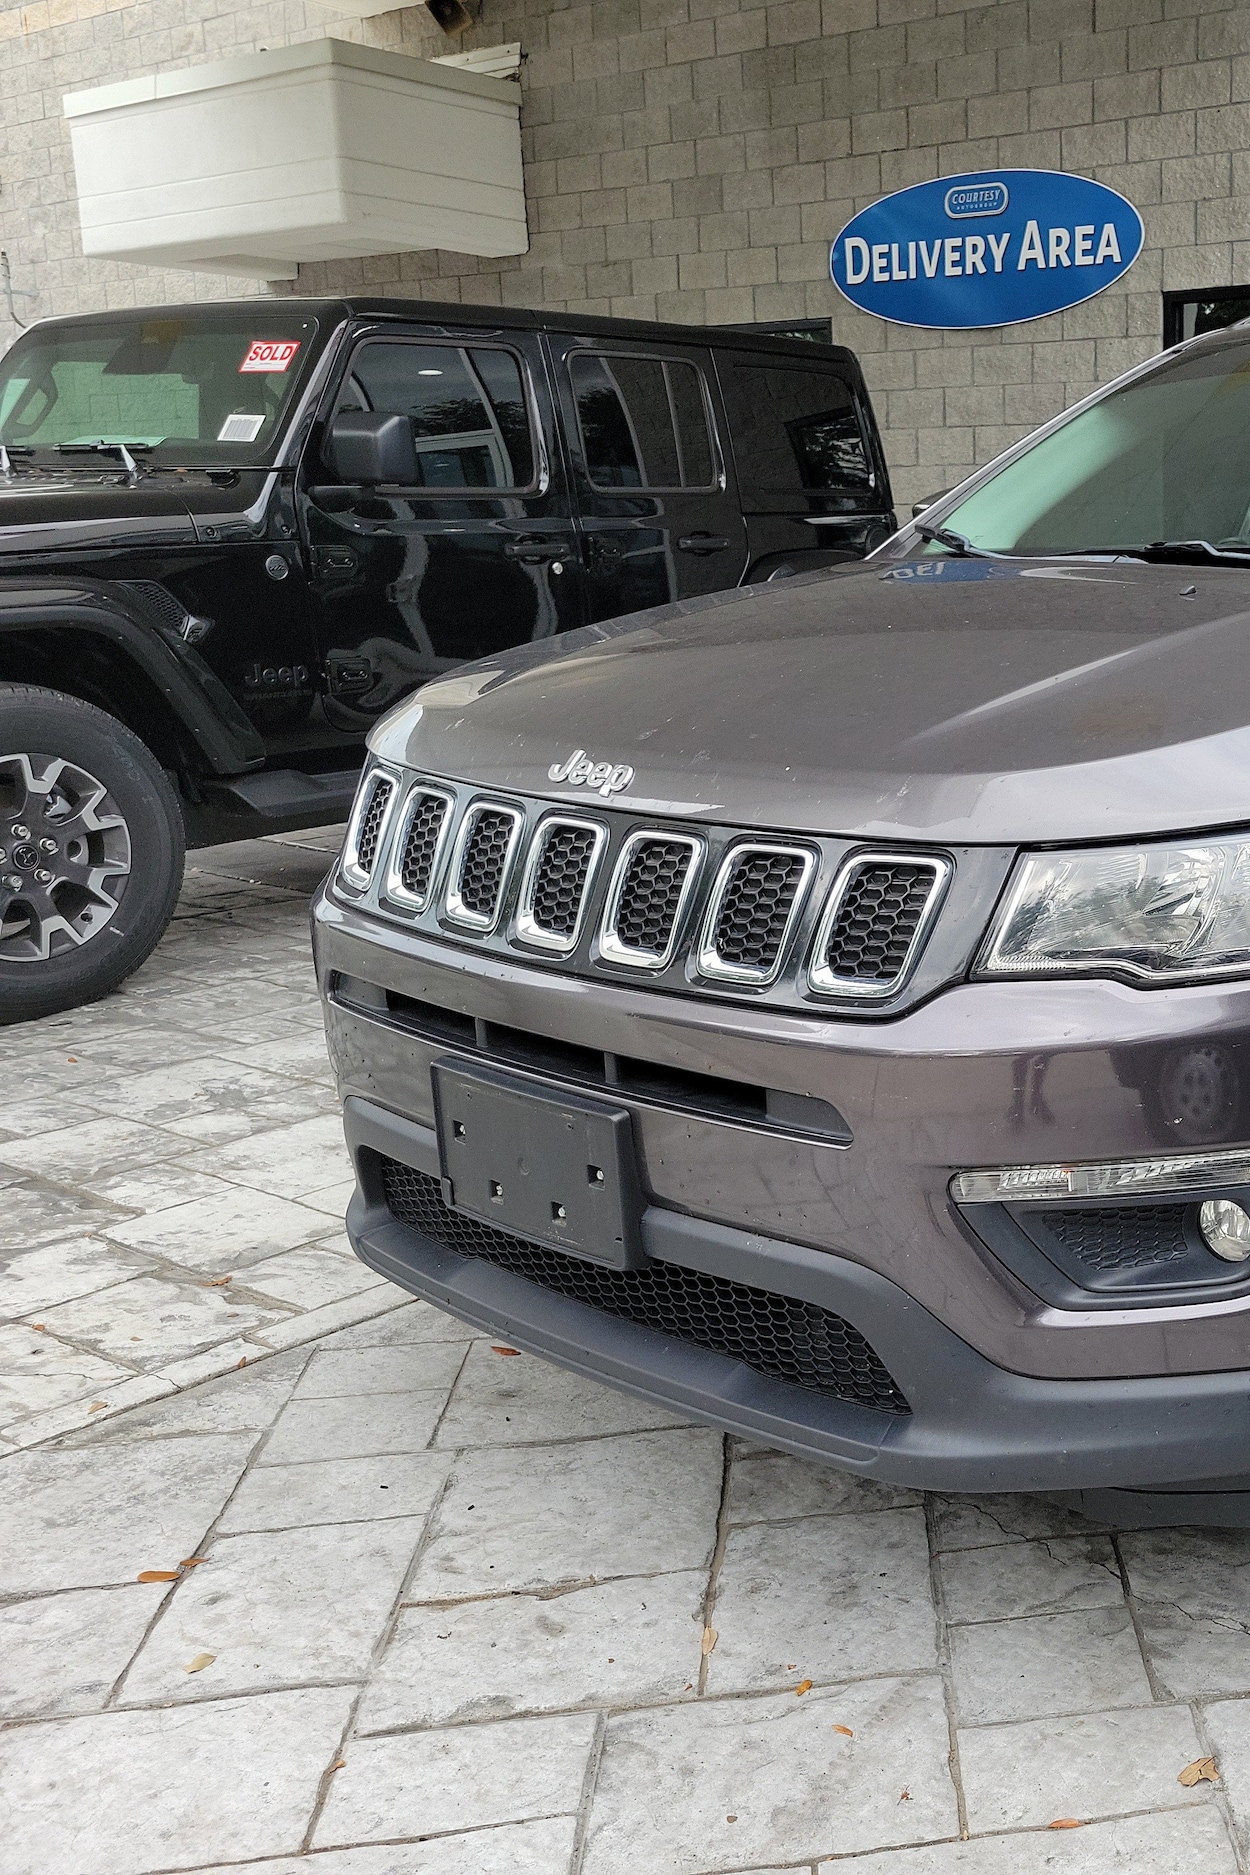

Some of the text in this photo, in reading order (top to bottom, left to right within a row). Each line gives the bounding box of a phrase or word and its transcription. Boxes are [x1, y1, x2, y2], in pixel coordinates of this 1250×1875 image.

[952, 189, 1001, 205] COURTESY
[844, 220, 1122, 285] DELIVERY AREA
[249, 346, 293, 361] SOLD
[245, 663, 309, 687] Jeep
[548, 750, 635, 798] Jeep
